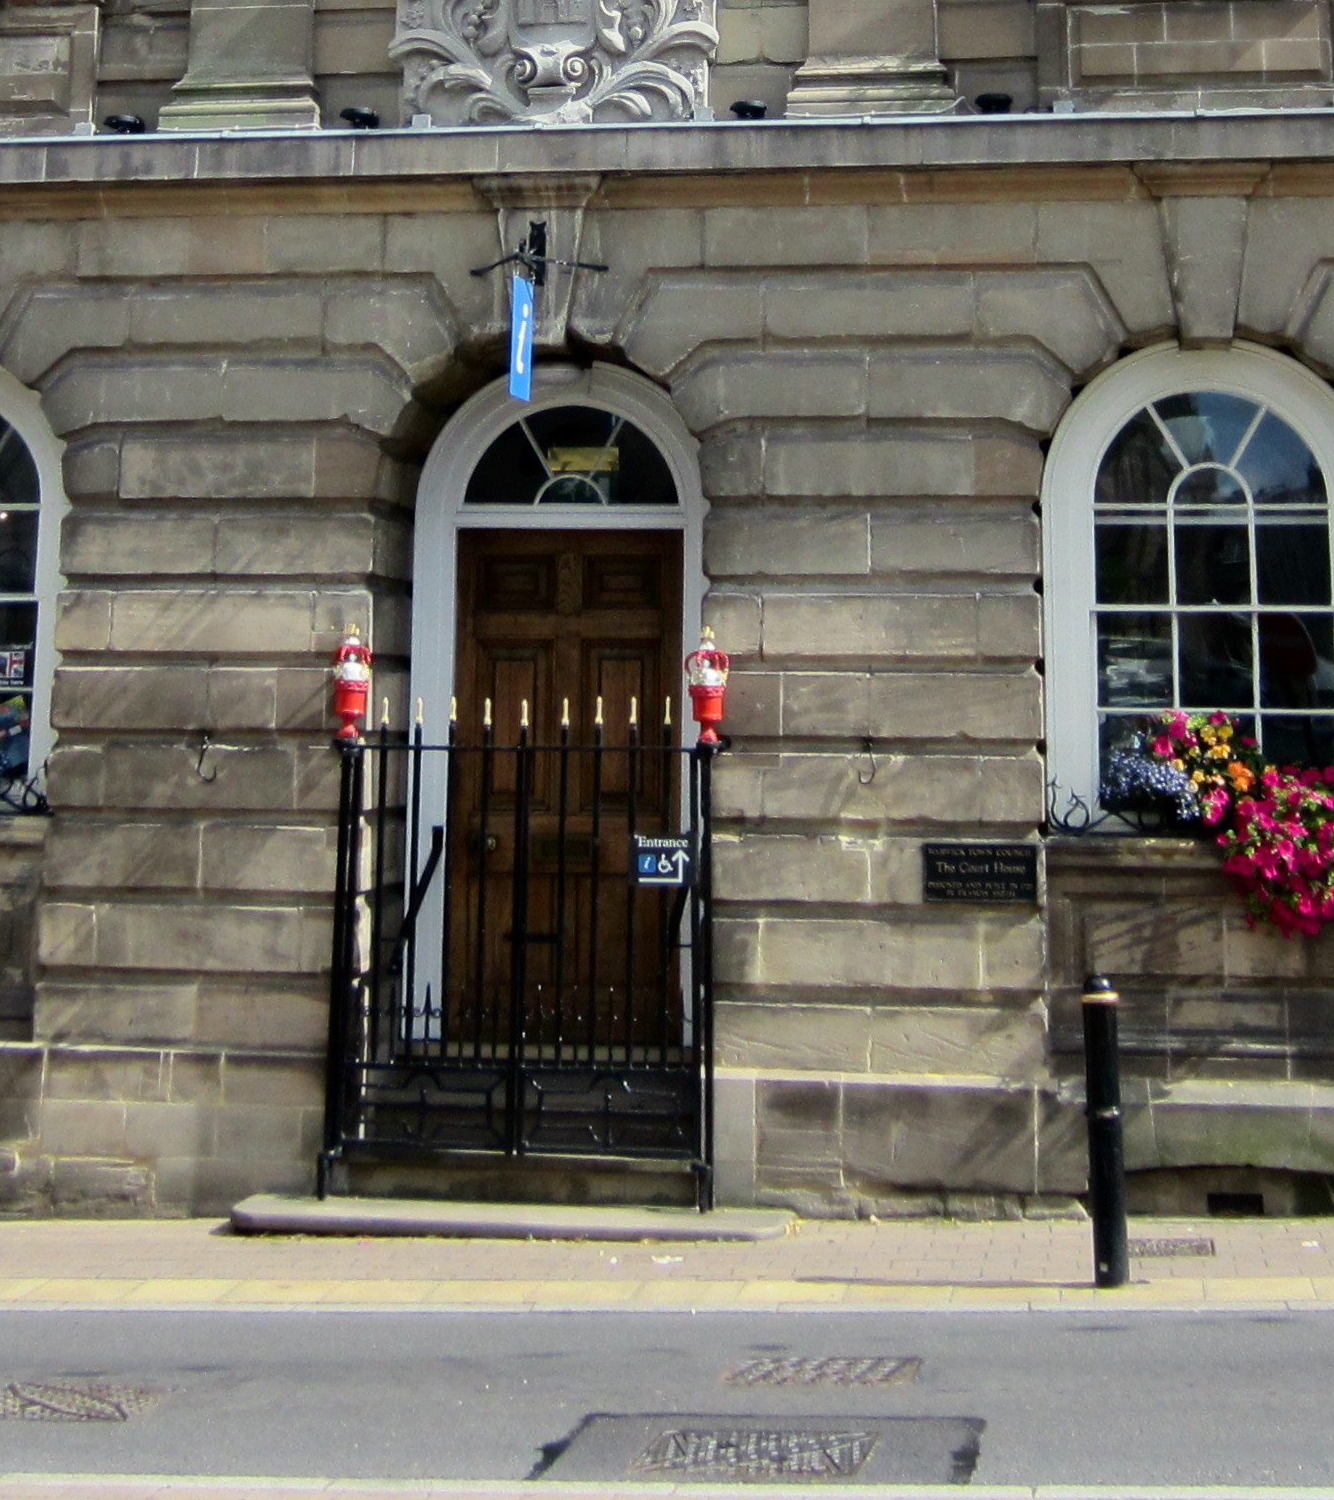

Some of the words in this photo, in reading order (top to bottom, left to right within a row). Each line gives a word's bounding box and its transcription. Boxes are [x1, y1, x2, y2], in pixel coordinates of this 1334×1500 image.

[638, 835, 689, 848] Entrance
[935, 861, 956, 874] The
[958, 861, 990, 874] Court
[993, 861, 1027, 874] House
